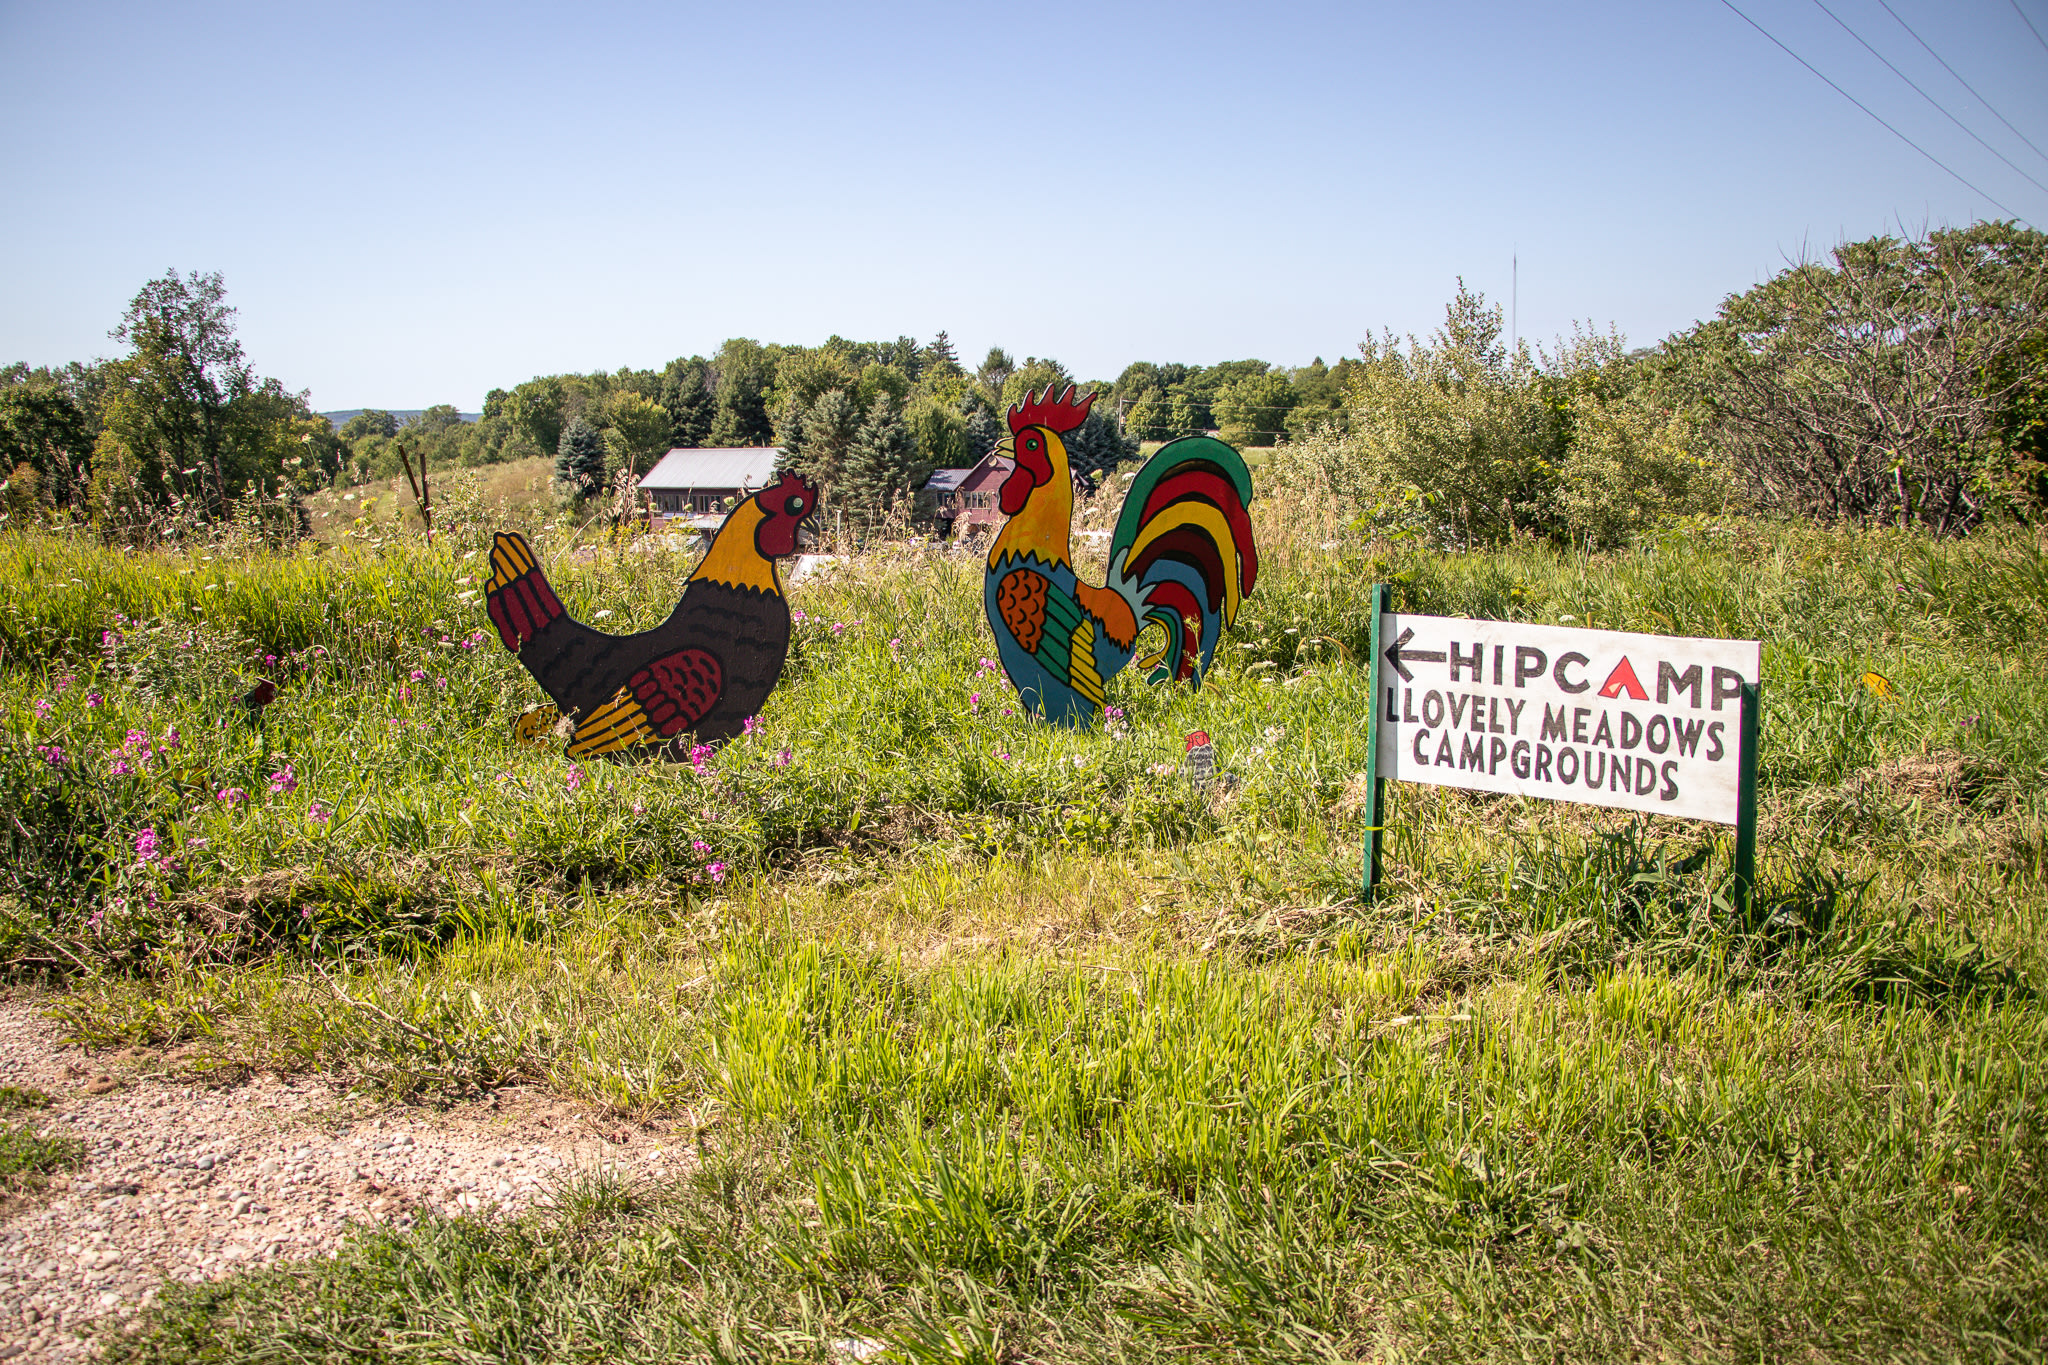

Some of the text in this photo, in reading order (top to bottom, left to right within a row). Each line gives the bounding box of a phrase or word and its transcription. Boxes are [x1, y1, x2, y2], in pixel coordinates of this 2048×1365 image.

[1450, 641, 1744, 710] HIPCAMP
[1413, 729, 1679, 801] CAMPGROUNDS
[1541, 702, 1725, 761] MEADOWS
